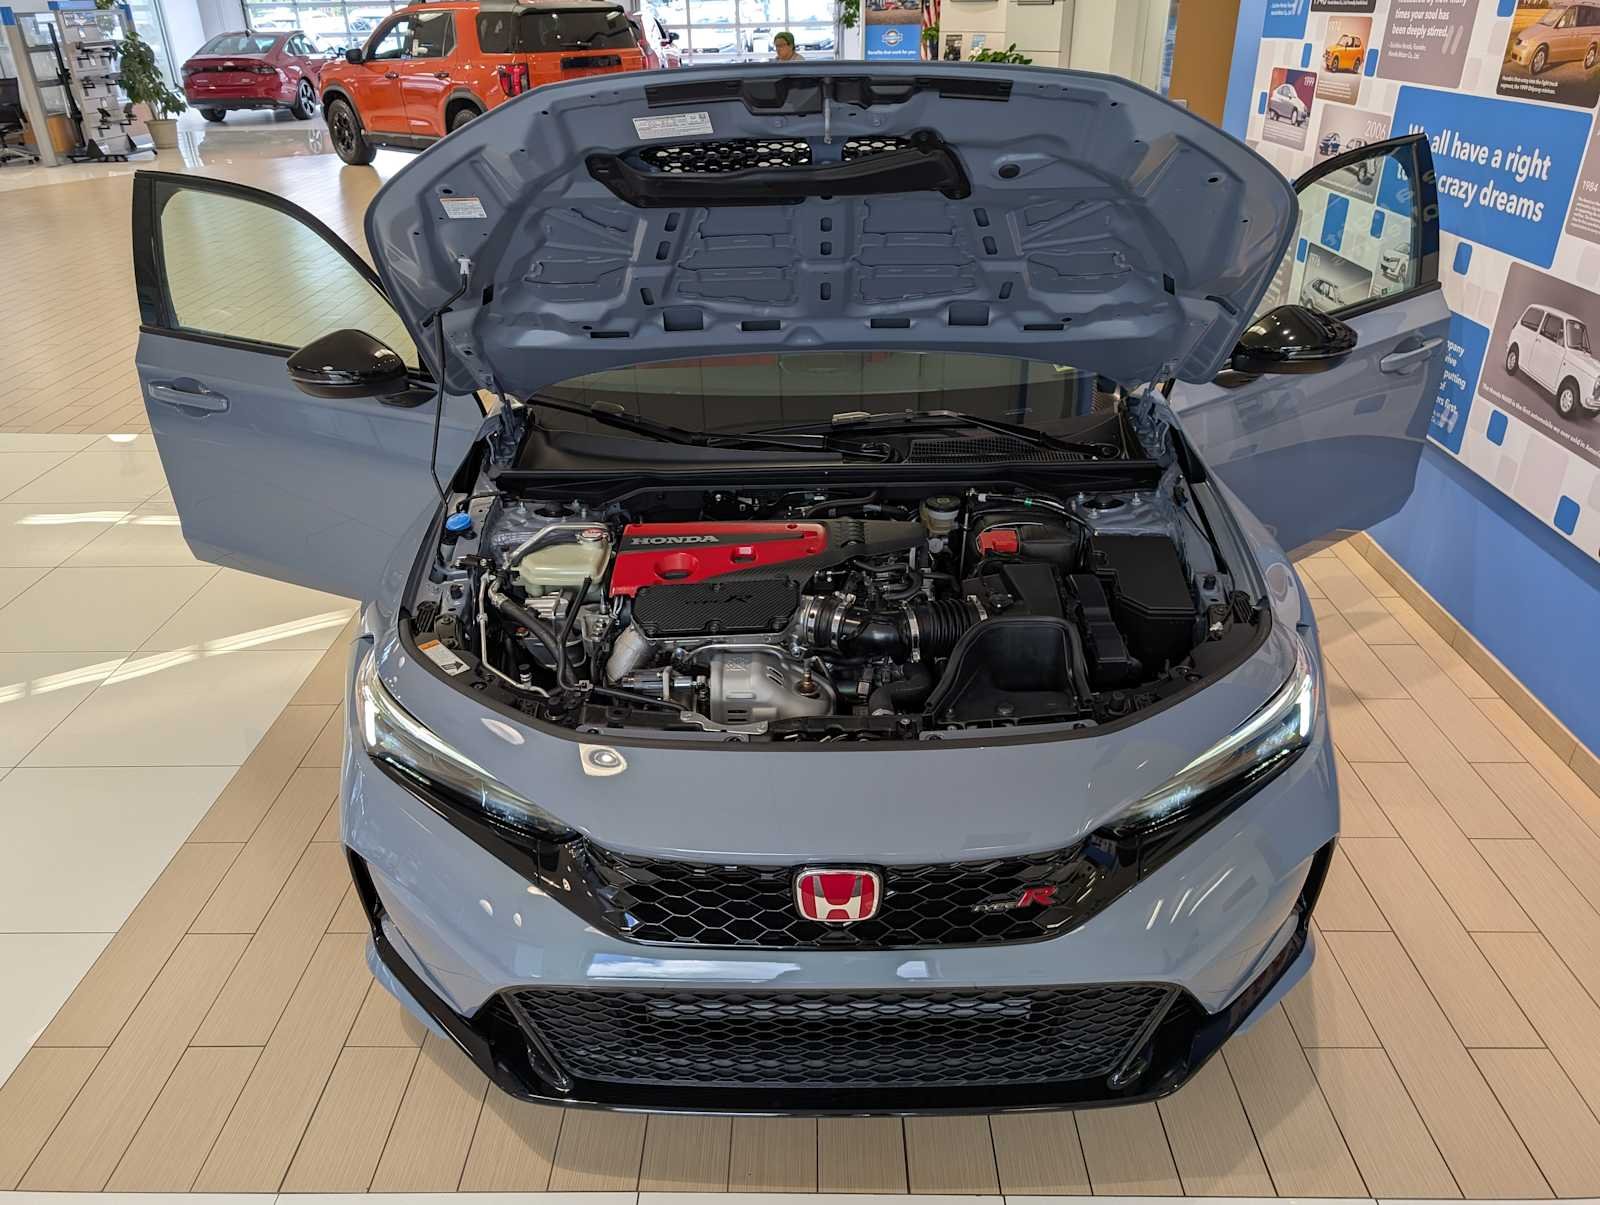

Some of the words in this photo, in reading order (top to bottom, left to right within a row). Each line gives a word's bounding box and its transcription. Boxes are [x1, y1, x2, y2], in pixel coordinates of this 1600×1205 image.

[1395, 8, 1410, 19] times
[1410, 10, 1424, 21] your
[1424, 8, 1438, 19] soul
[1438, 8, 1450, 20] has
[1392, 24, 1406, 34] been
[1407, 24, 1427, 38] deeply
[1430, 128, 1451, 155] all
[1451, 132, 1488, 165] have
[1491, 148, 1502, 169] a
[1504, 145, 1552, 183] right
[1438, 174, 1477, 208] crazy
[1479, 180, 1544, 222] dreams
[1443, 369, 1466, 390] putting
[630, 535, 719, 545] HONDA
[1015, 885, 1057, 909] R
